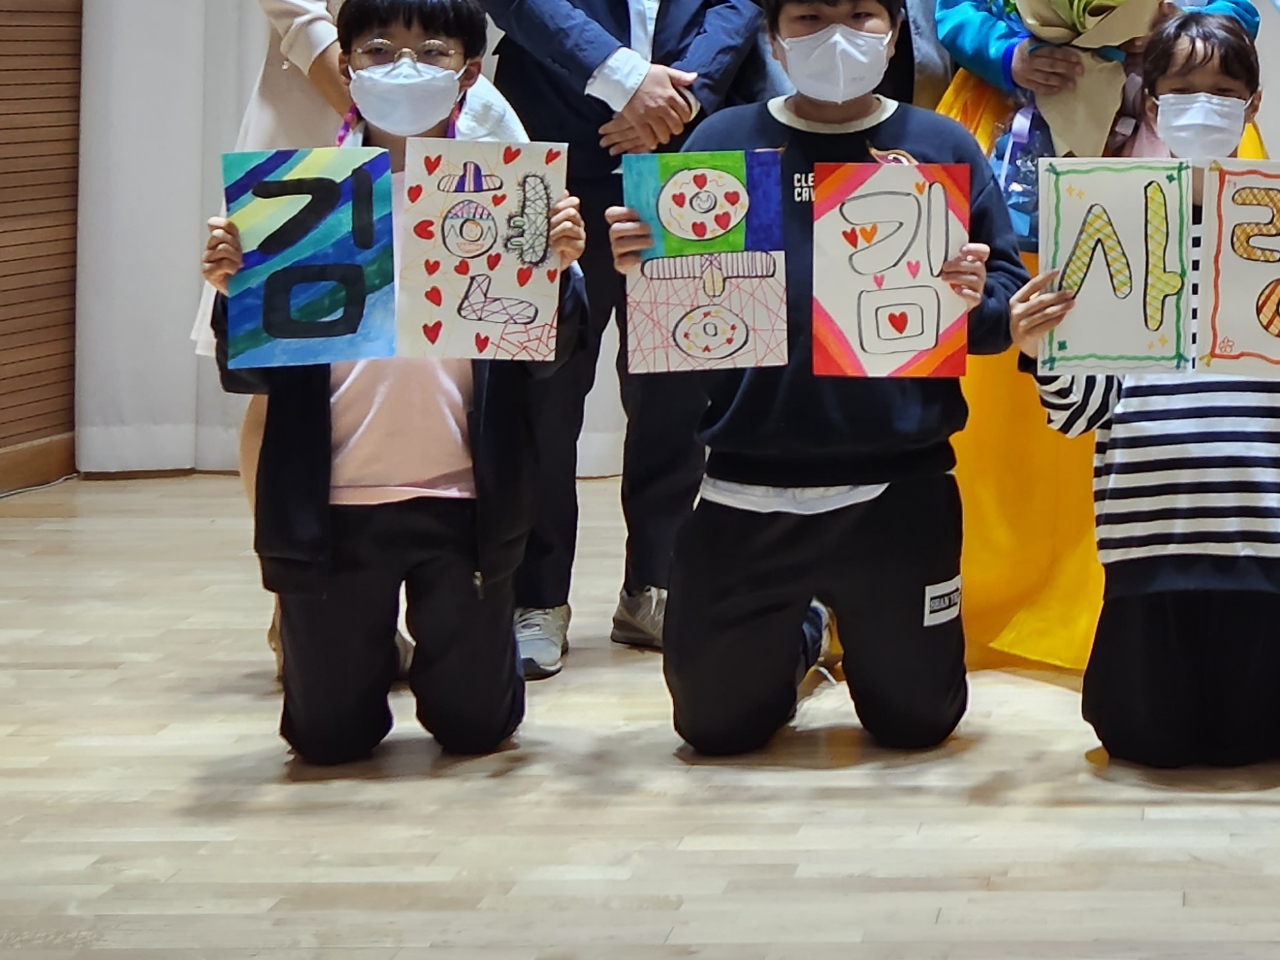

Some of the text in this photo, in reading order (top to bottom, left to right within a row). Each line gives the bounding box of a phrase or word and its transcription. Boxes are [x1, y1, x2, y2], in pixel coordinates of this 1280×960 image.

[252, 166, 374, 339] 김
[839, 181, 948, 354] 김
[1059, 179, 1185, 332] 사
